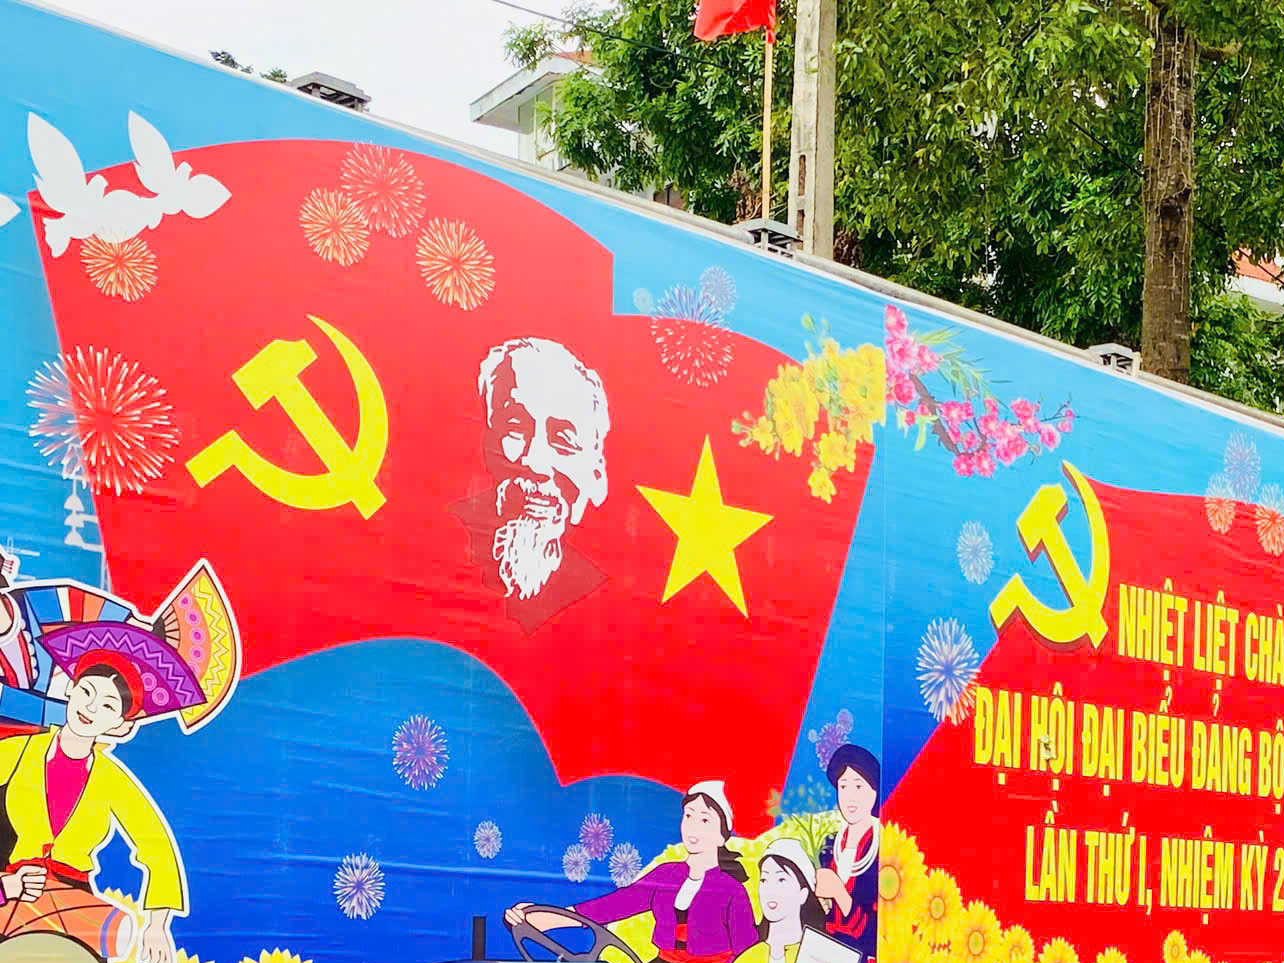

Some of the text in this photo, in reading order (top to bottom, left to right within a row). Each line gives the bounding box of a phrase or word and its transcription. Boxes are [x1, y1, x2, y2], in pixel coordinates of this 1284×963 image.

[1118, 578, 1188, 680] NHIỆT
[1194, 590, 1240, 690] LIỆT
[974, 686, 1022, 785] ĐẠI
[1030, 681, 1074, 791] HỘI
[1082, 703, 1124, 796] ĐẠI
[1131, 686, 1185, 788] BIỂU
[1191, 693, 1252, 795] ĐẢNG
[1025, 800, 1077, 903] LẦN
[1084, 812, 1135, 906] THỨ
[1138, 835, 1152, 915] I,
[1160, 825, 1234, 925] NHIỆM
[1240, 830, 1268, 911] KỲ
